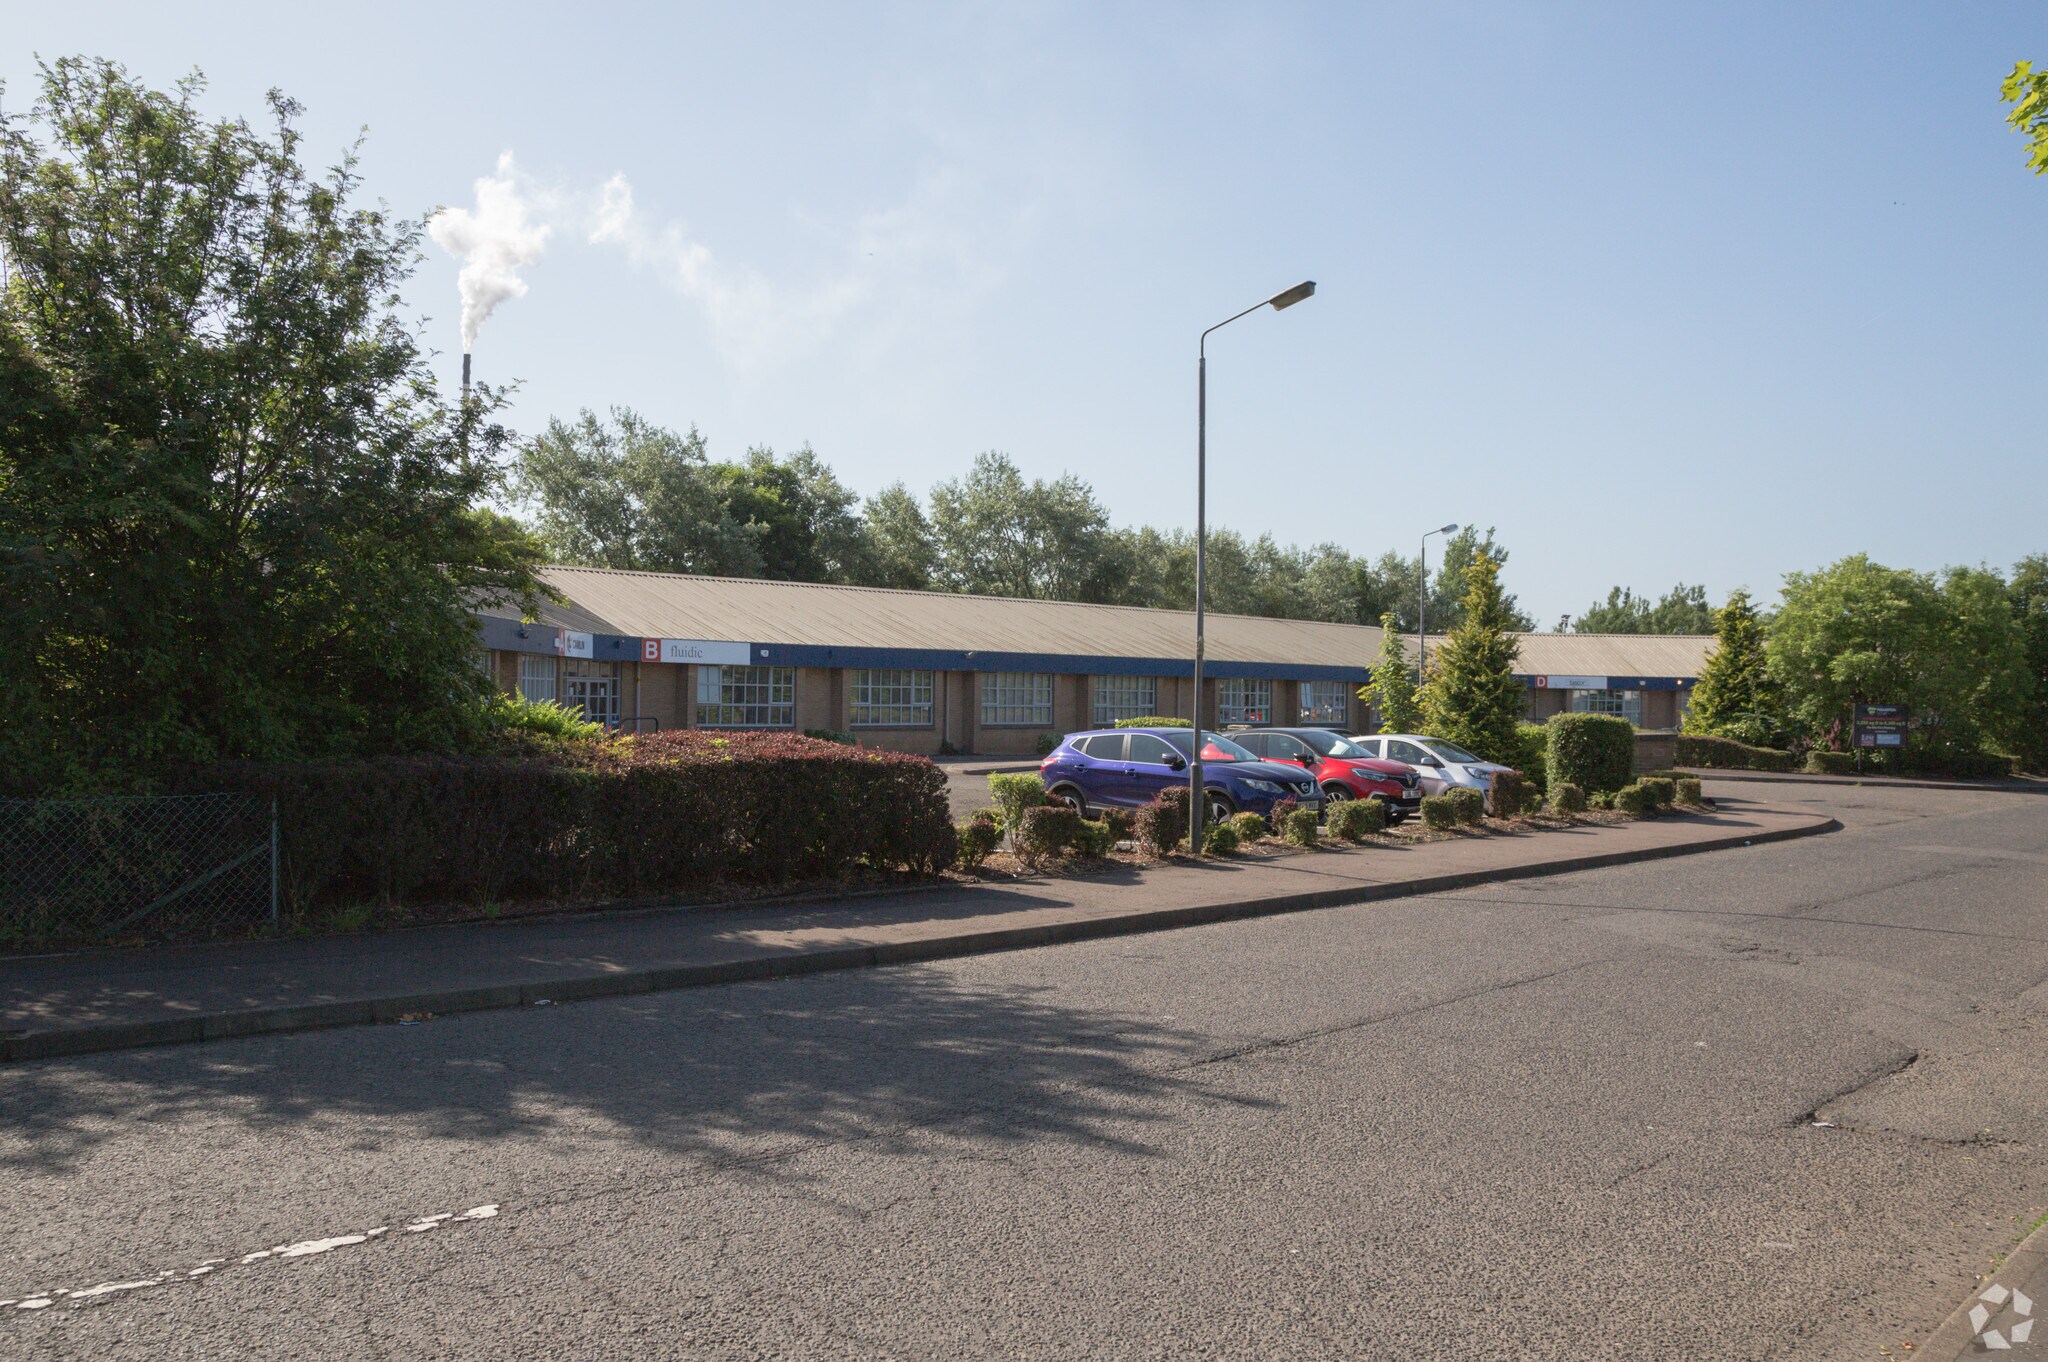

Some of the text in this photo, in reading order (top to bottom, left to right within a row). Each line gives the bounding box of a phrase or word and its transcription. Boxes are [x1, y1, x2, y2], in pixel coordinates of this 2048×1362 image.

[645, 640, 703, 659] B fluidic
[1537, 676, 1546, 687] D
